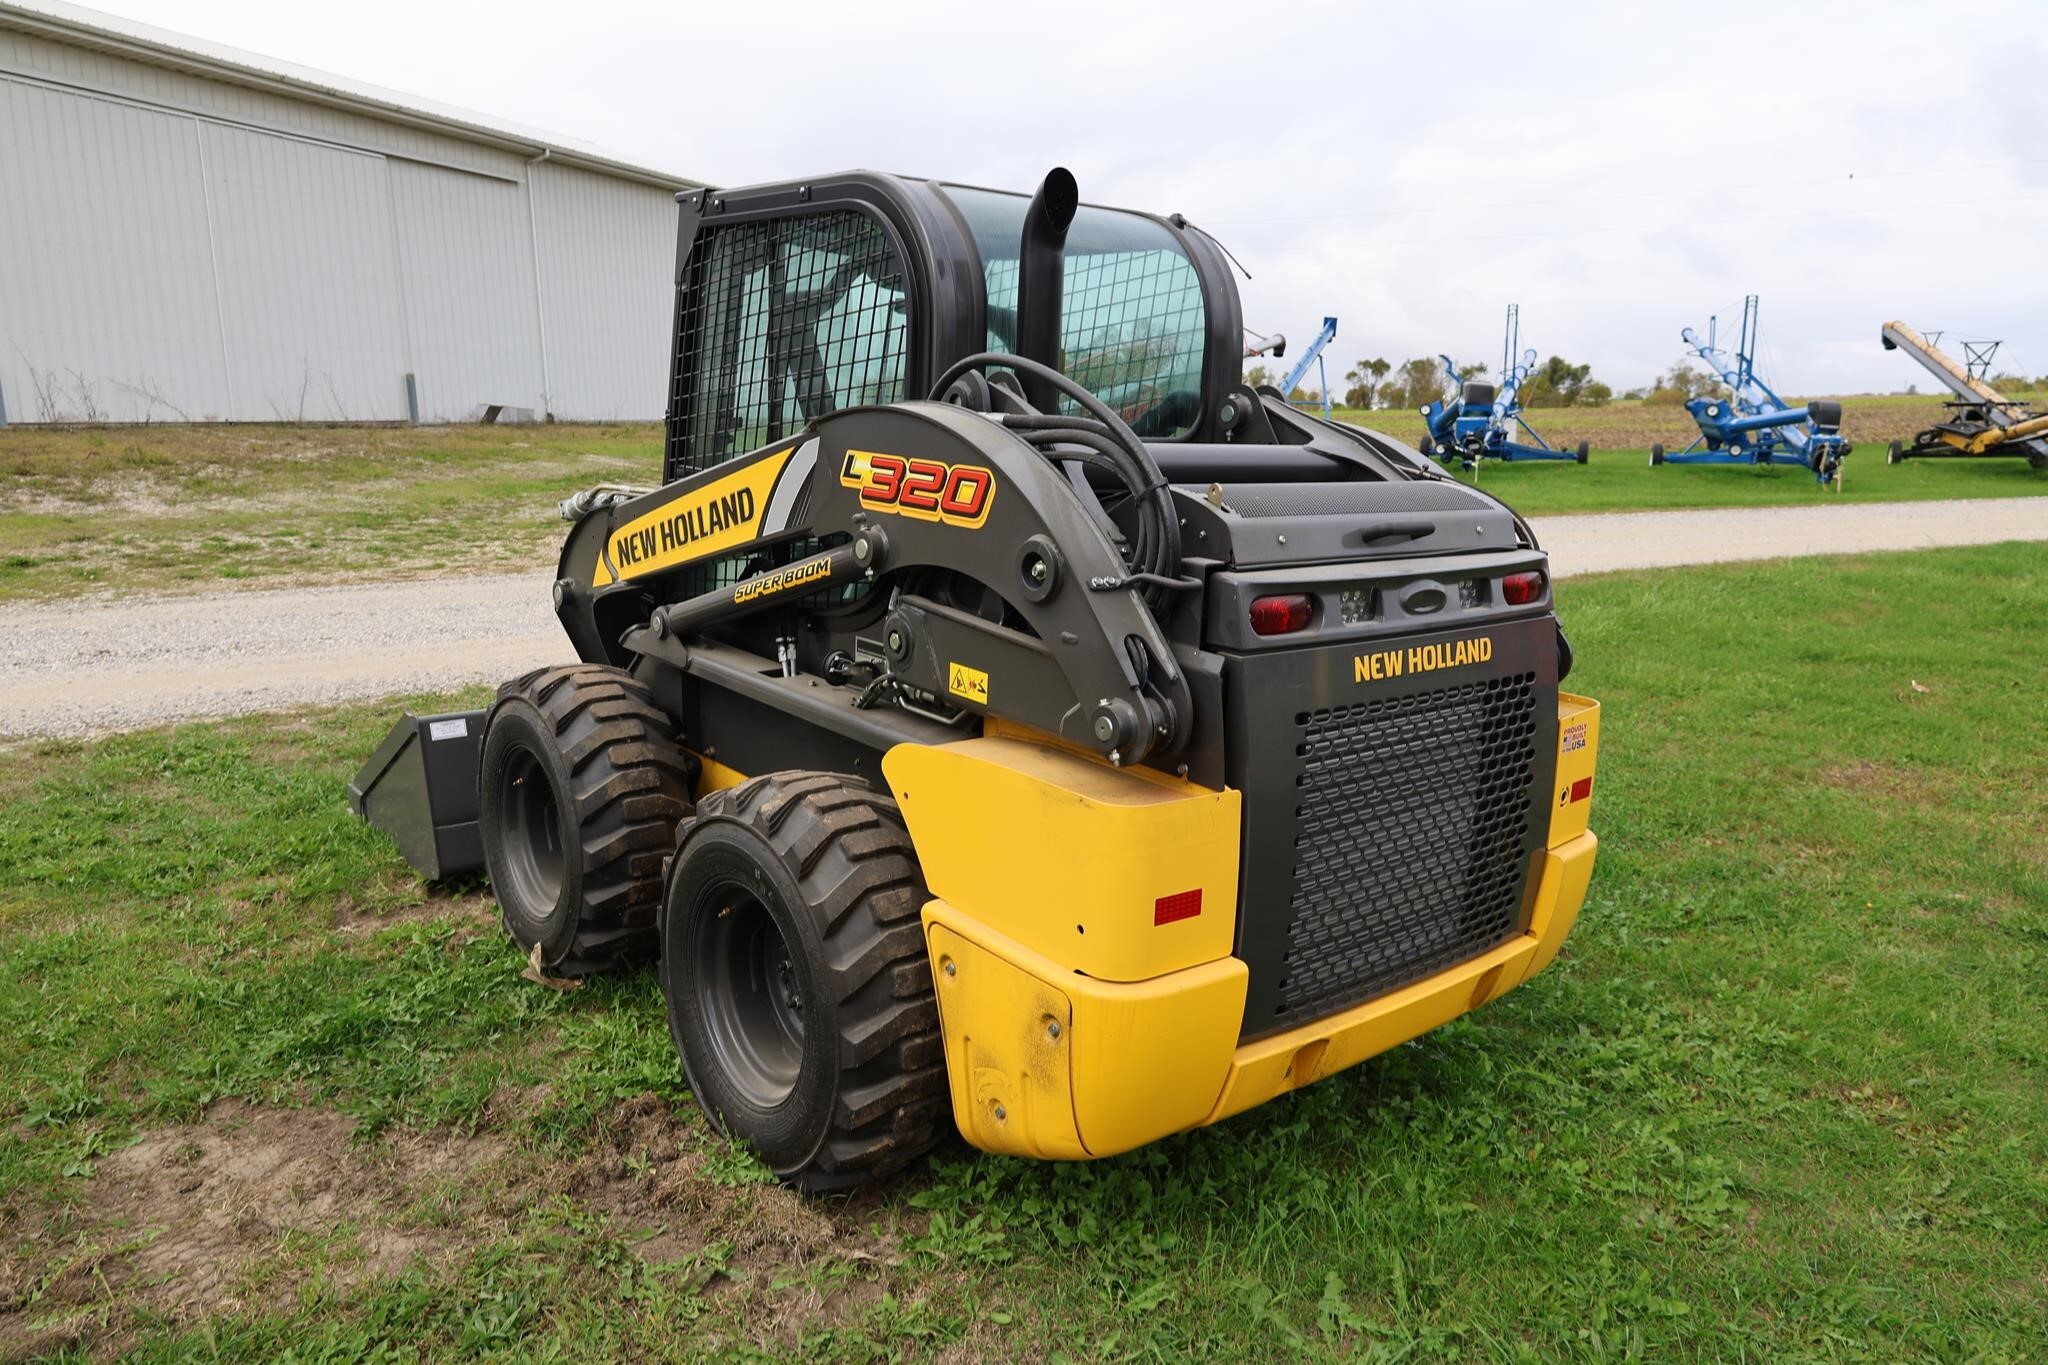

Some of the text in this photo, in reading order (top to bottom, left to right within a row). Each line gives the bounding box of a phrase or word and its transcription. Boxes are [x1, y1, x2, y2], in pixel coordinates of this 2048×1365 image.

[843, 453, 992, 519] L320
[617, 486, 755, 569] NEW HOLLAND
[735, 559, 830, 600] SUPER BOOM
[1353, 636, 1492, 683] NEW HOLLAND
[1571, 739, 1586, 750] USA
